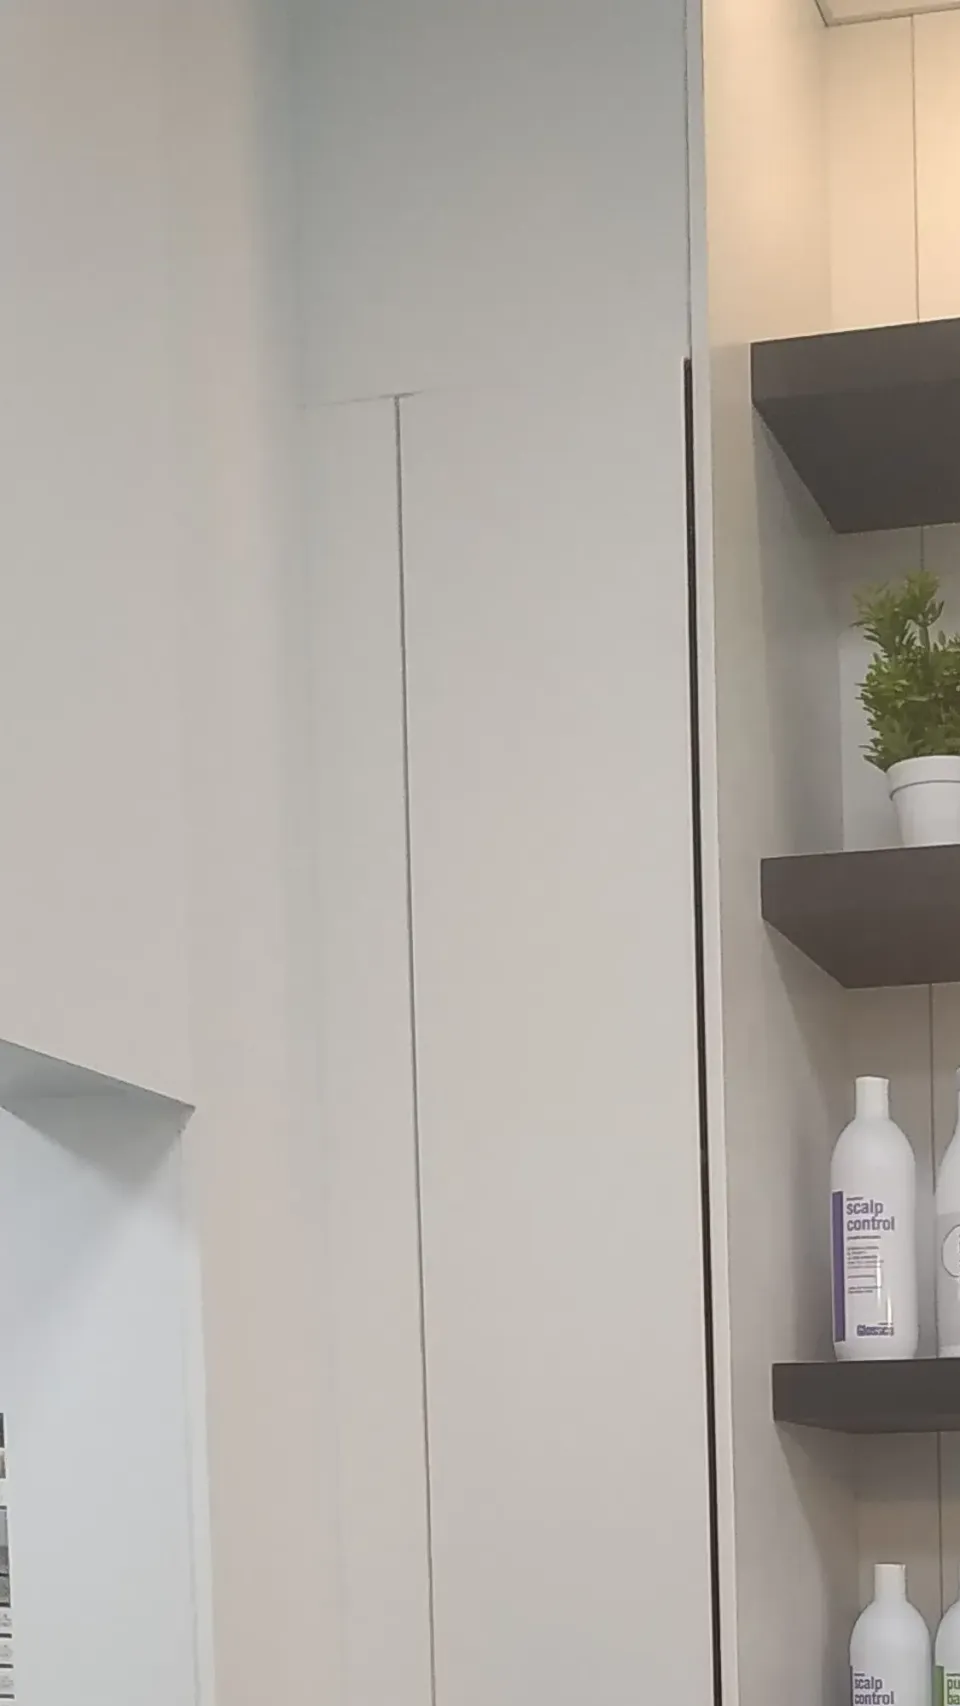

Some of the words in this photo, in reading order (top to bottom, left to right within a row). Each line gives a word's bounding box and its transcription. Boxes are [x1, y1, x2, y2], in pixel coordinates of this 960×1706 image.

[846, 1199, 884, 1217] scalp
[846, 1216, 895, 1231] control
[854, 1676, 883, 1692] scalp
[854, 1691, 895, 1705] control
